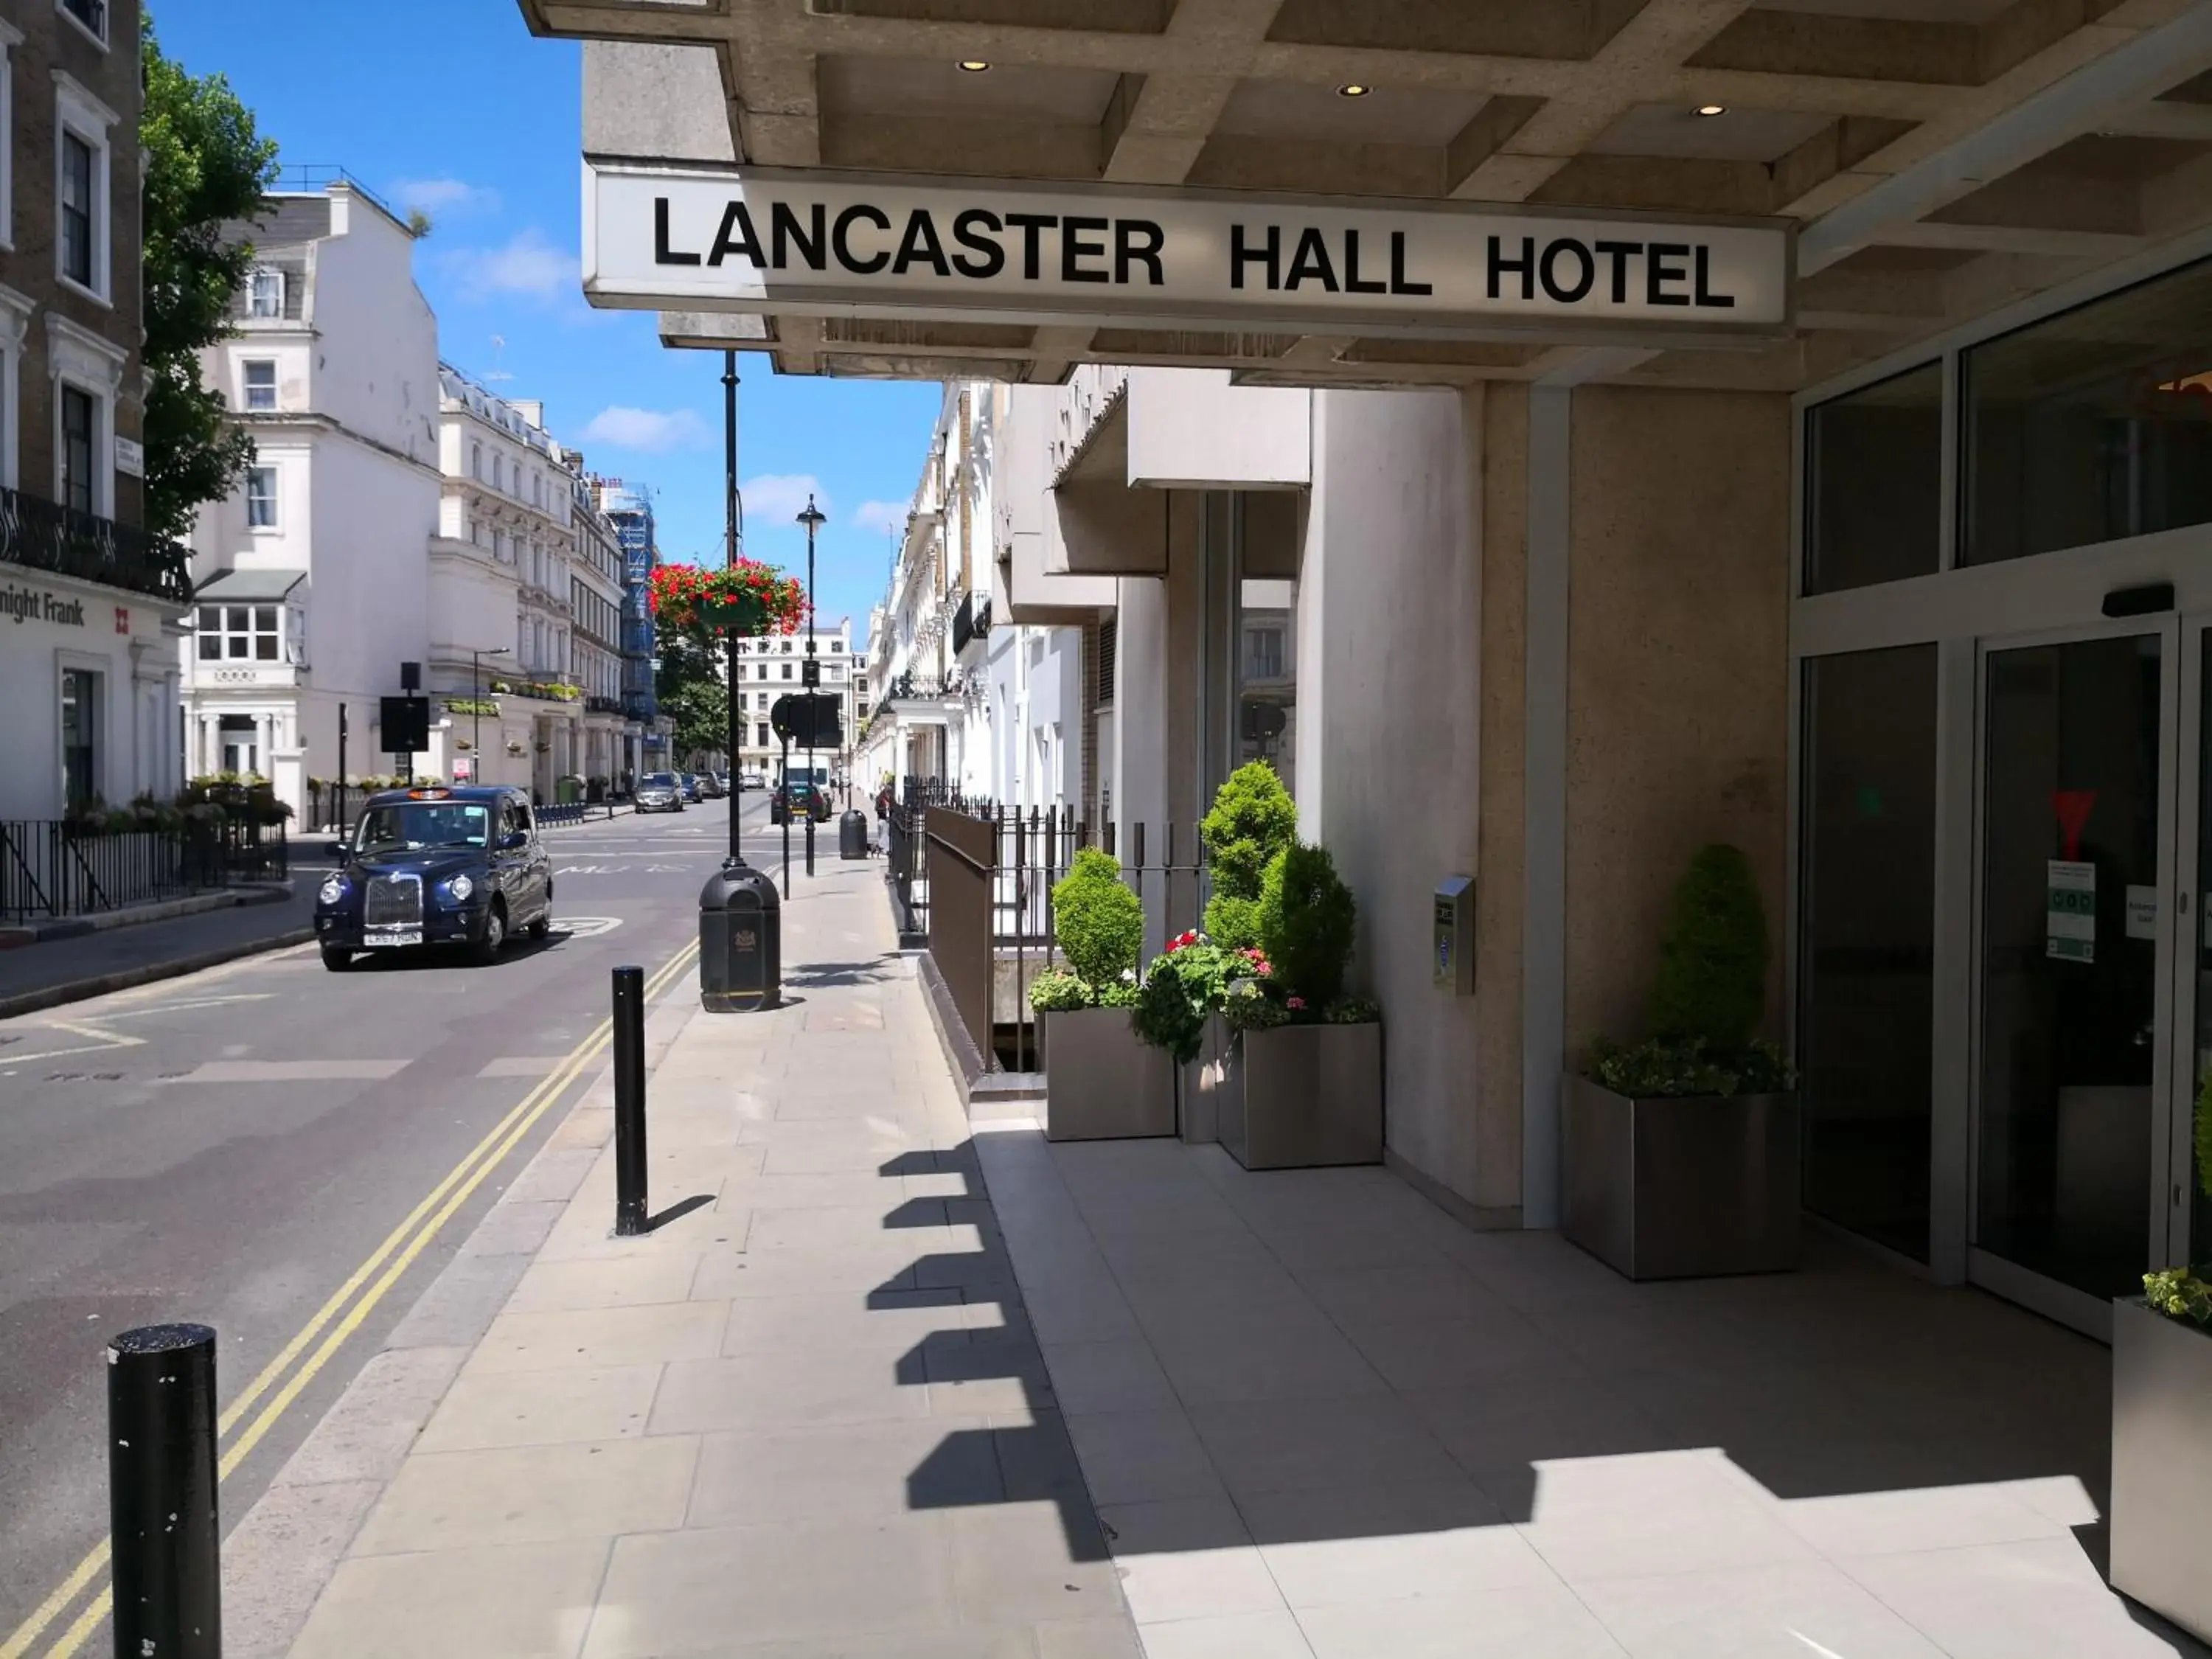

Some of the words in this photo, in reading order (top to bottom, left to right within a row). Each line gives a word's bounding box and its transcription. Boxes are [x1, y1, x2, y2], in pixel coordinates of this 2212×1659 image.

[653, 197, 1165, 285] LANCASTER
[1230, 224, 1433, 296] HALL
[1486, 234, 1735, 307] HOTEL
[0, 583, 41, 625] night
[44, 591, 85, 628] Frank
